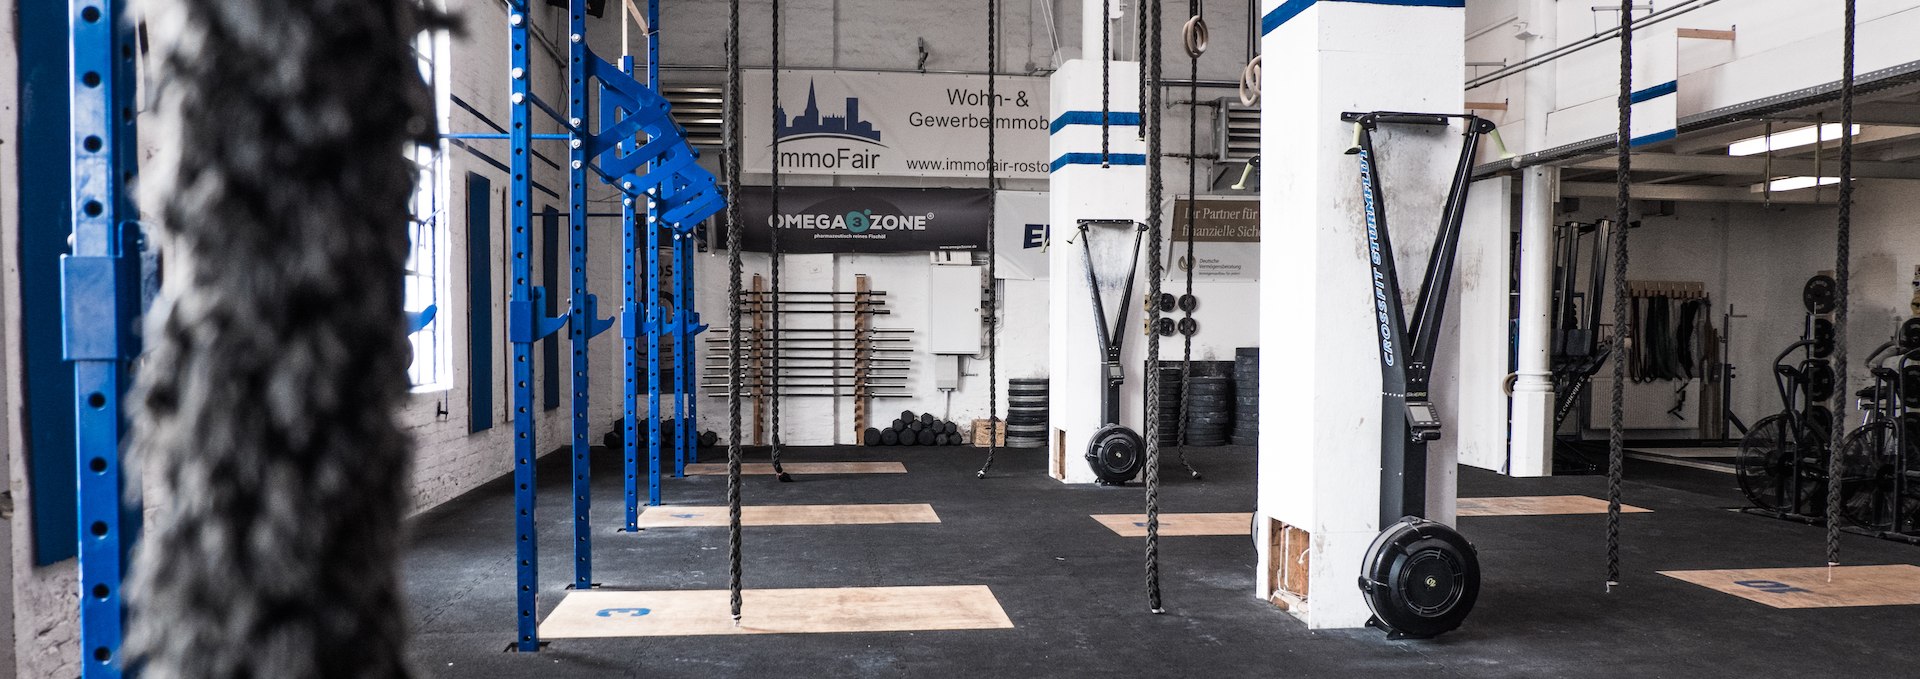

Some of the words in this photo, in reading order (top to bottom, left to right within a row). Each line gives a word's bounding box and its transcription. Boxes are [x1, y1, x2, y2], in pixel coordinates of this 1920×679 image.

[947, 88, 1011, 107] Wohn-
[1016, 90, 1029, 107] &
[909, 111, 1050, 130] Gewerbemmob
[774, 148, 880, 169] mmoFair
[1203, 207, 1240, 220] Partner
[1242, 207, 1258, 220] für
[1359, 149, 1382, 266] STURMFLUT
[1373, 267, 1394, 367] CROSSFIT
